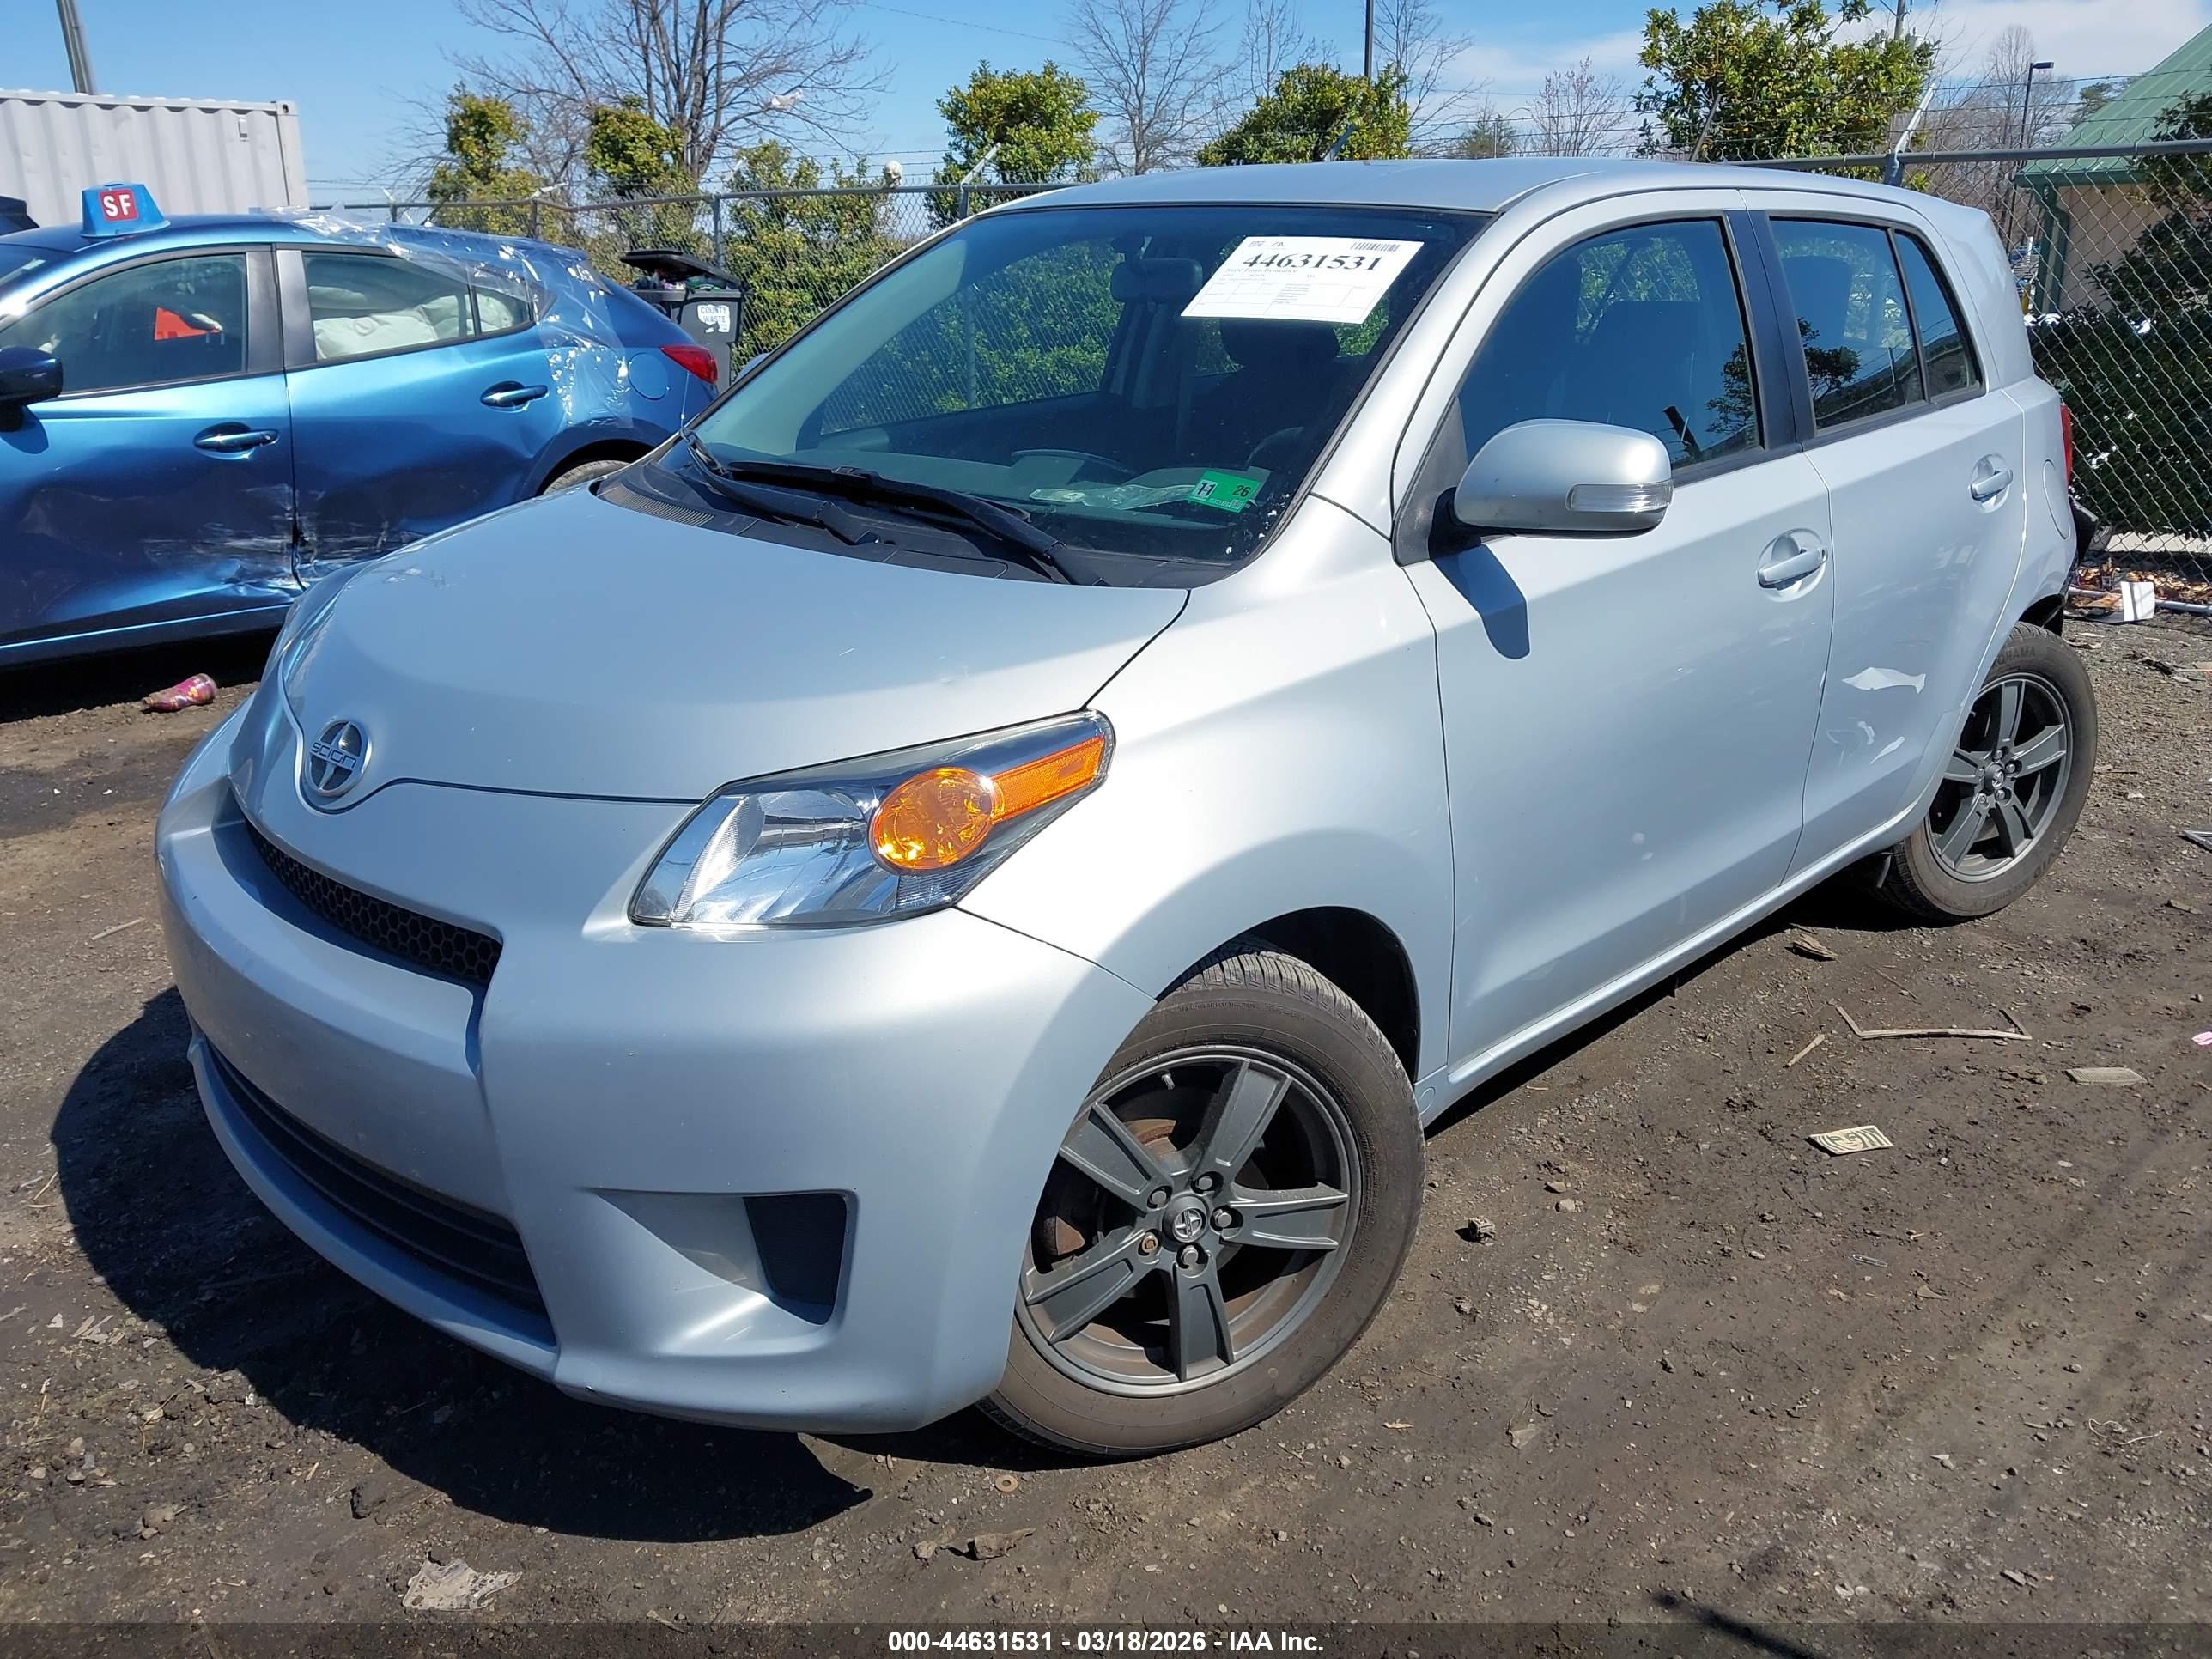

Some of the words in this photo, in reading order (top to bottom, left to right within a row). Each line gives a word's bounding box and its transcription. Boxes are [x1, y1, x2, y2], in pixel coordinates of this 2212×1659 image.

[103, 194, 131, 217] SF
[1243, 252, 1382, 271] 44631531
[700, 306, 727, 314] COUNTY
[1232, 484, 1252, 498] 26
[310, 741, 357, 769] SCION
